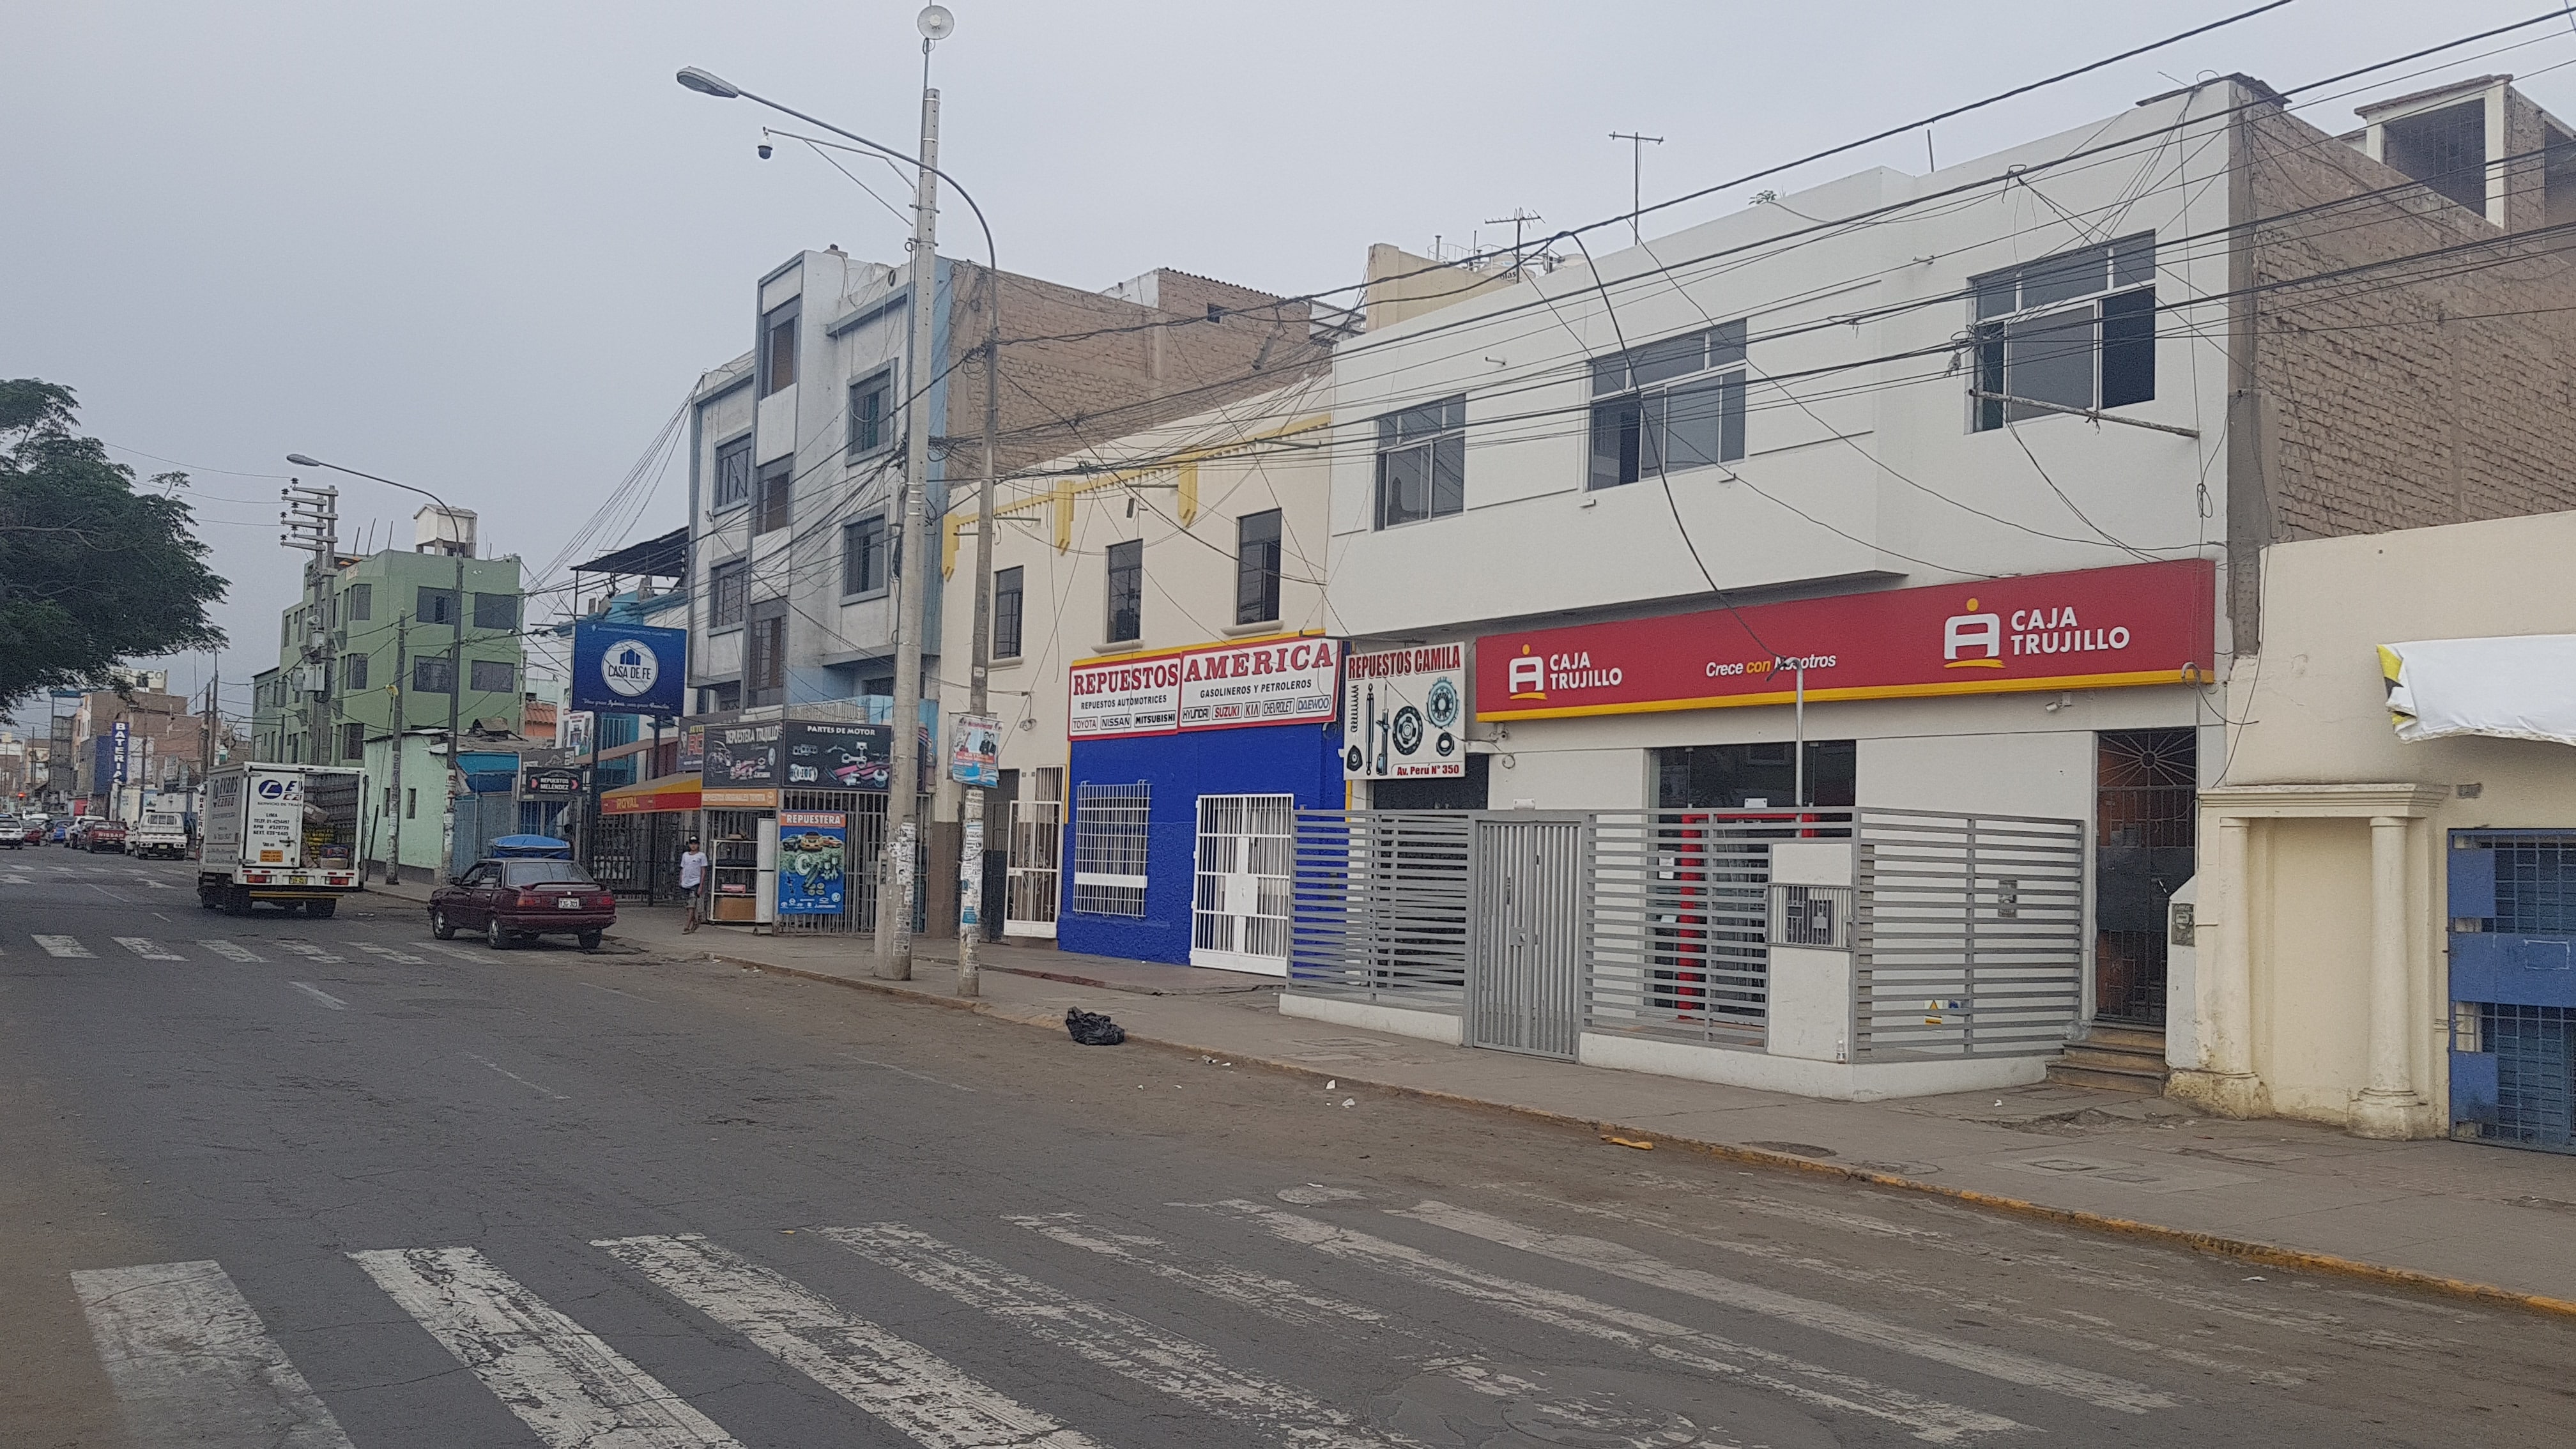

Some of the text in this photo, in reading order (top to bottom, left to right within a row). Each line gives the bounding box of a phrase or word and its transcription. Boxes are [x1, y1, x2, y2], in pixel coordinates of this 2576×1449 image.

[2011, 606, 2078, 631] CAJA
[2011, 626, 2130, 656] TRUJILLO
[1073, 643, 1333, 695] REPUESTOS AMERICA
[1348, 645, 1460, 679] REPUESTOS CAMILA
[1549, 652, 1591, 671] CAJA
[1706, 662, 1744, 677] Crece
[1746, 660, 1771, 673] con
[608, 664, 651, 679] CASA DE FE
[1549, 668, 1623, 690] TRUJILLO
[1200, 679, 1312, 698] GASOLINEROS Y PETROLEROS
[1081, 694, 1167, 710] REPUESTOS AUTOMOTRICES
[1183, 697, 1330, 720] HYUNDAI SUZUKI KIA CHEVROLET DAEWOO
[807, 725, 835, 733] PARTES
[1073, 713, 1176, 729] TOYOTA NISSAN MITSUBISHI
[725, 724, 779, 744] REPUESTERA TRUJILLO
[1397, 767, 1408, 776] Av.
[1410, 763, 1430, 775] Perú
[1442, 765, 1459, 774] 350
[616, 797, 639, 809] ROYAL
